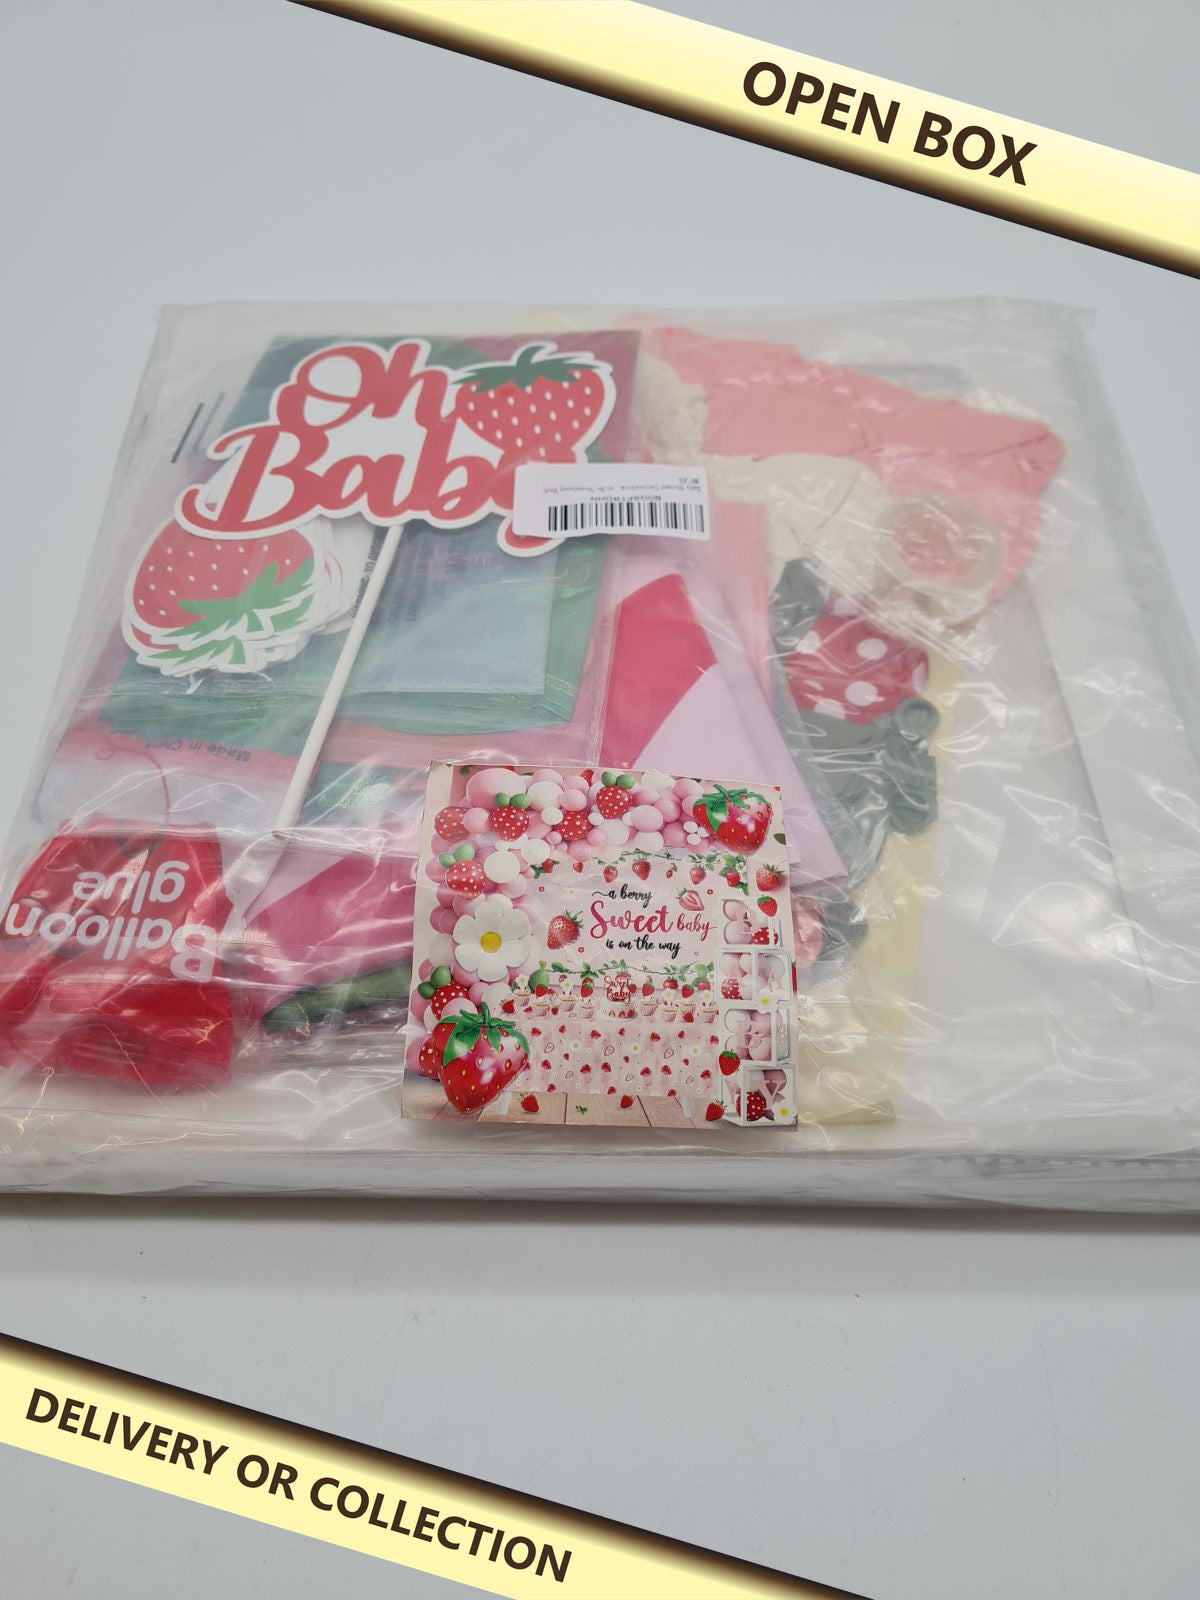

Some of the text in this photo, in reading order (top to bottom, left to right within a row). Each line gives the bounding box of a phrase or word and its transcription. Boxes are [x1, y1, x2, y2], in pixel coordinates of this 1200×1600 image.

[276, 342, 452, 429] Oh
[188, 741, 203, 754] in
[207, 743, 252, 762] Made
[72, 860, 190, 914] glue
[620, 883, 652, 909] berry
[590, 900, 717, 942] Sweet baby
[4, 903, 217, 984] Balloon
[605, 934, 681, 959] is on the way
